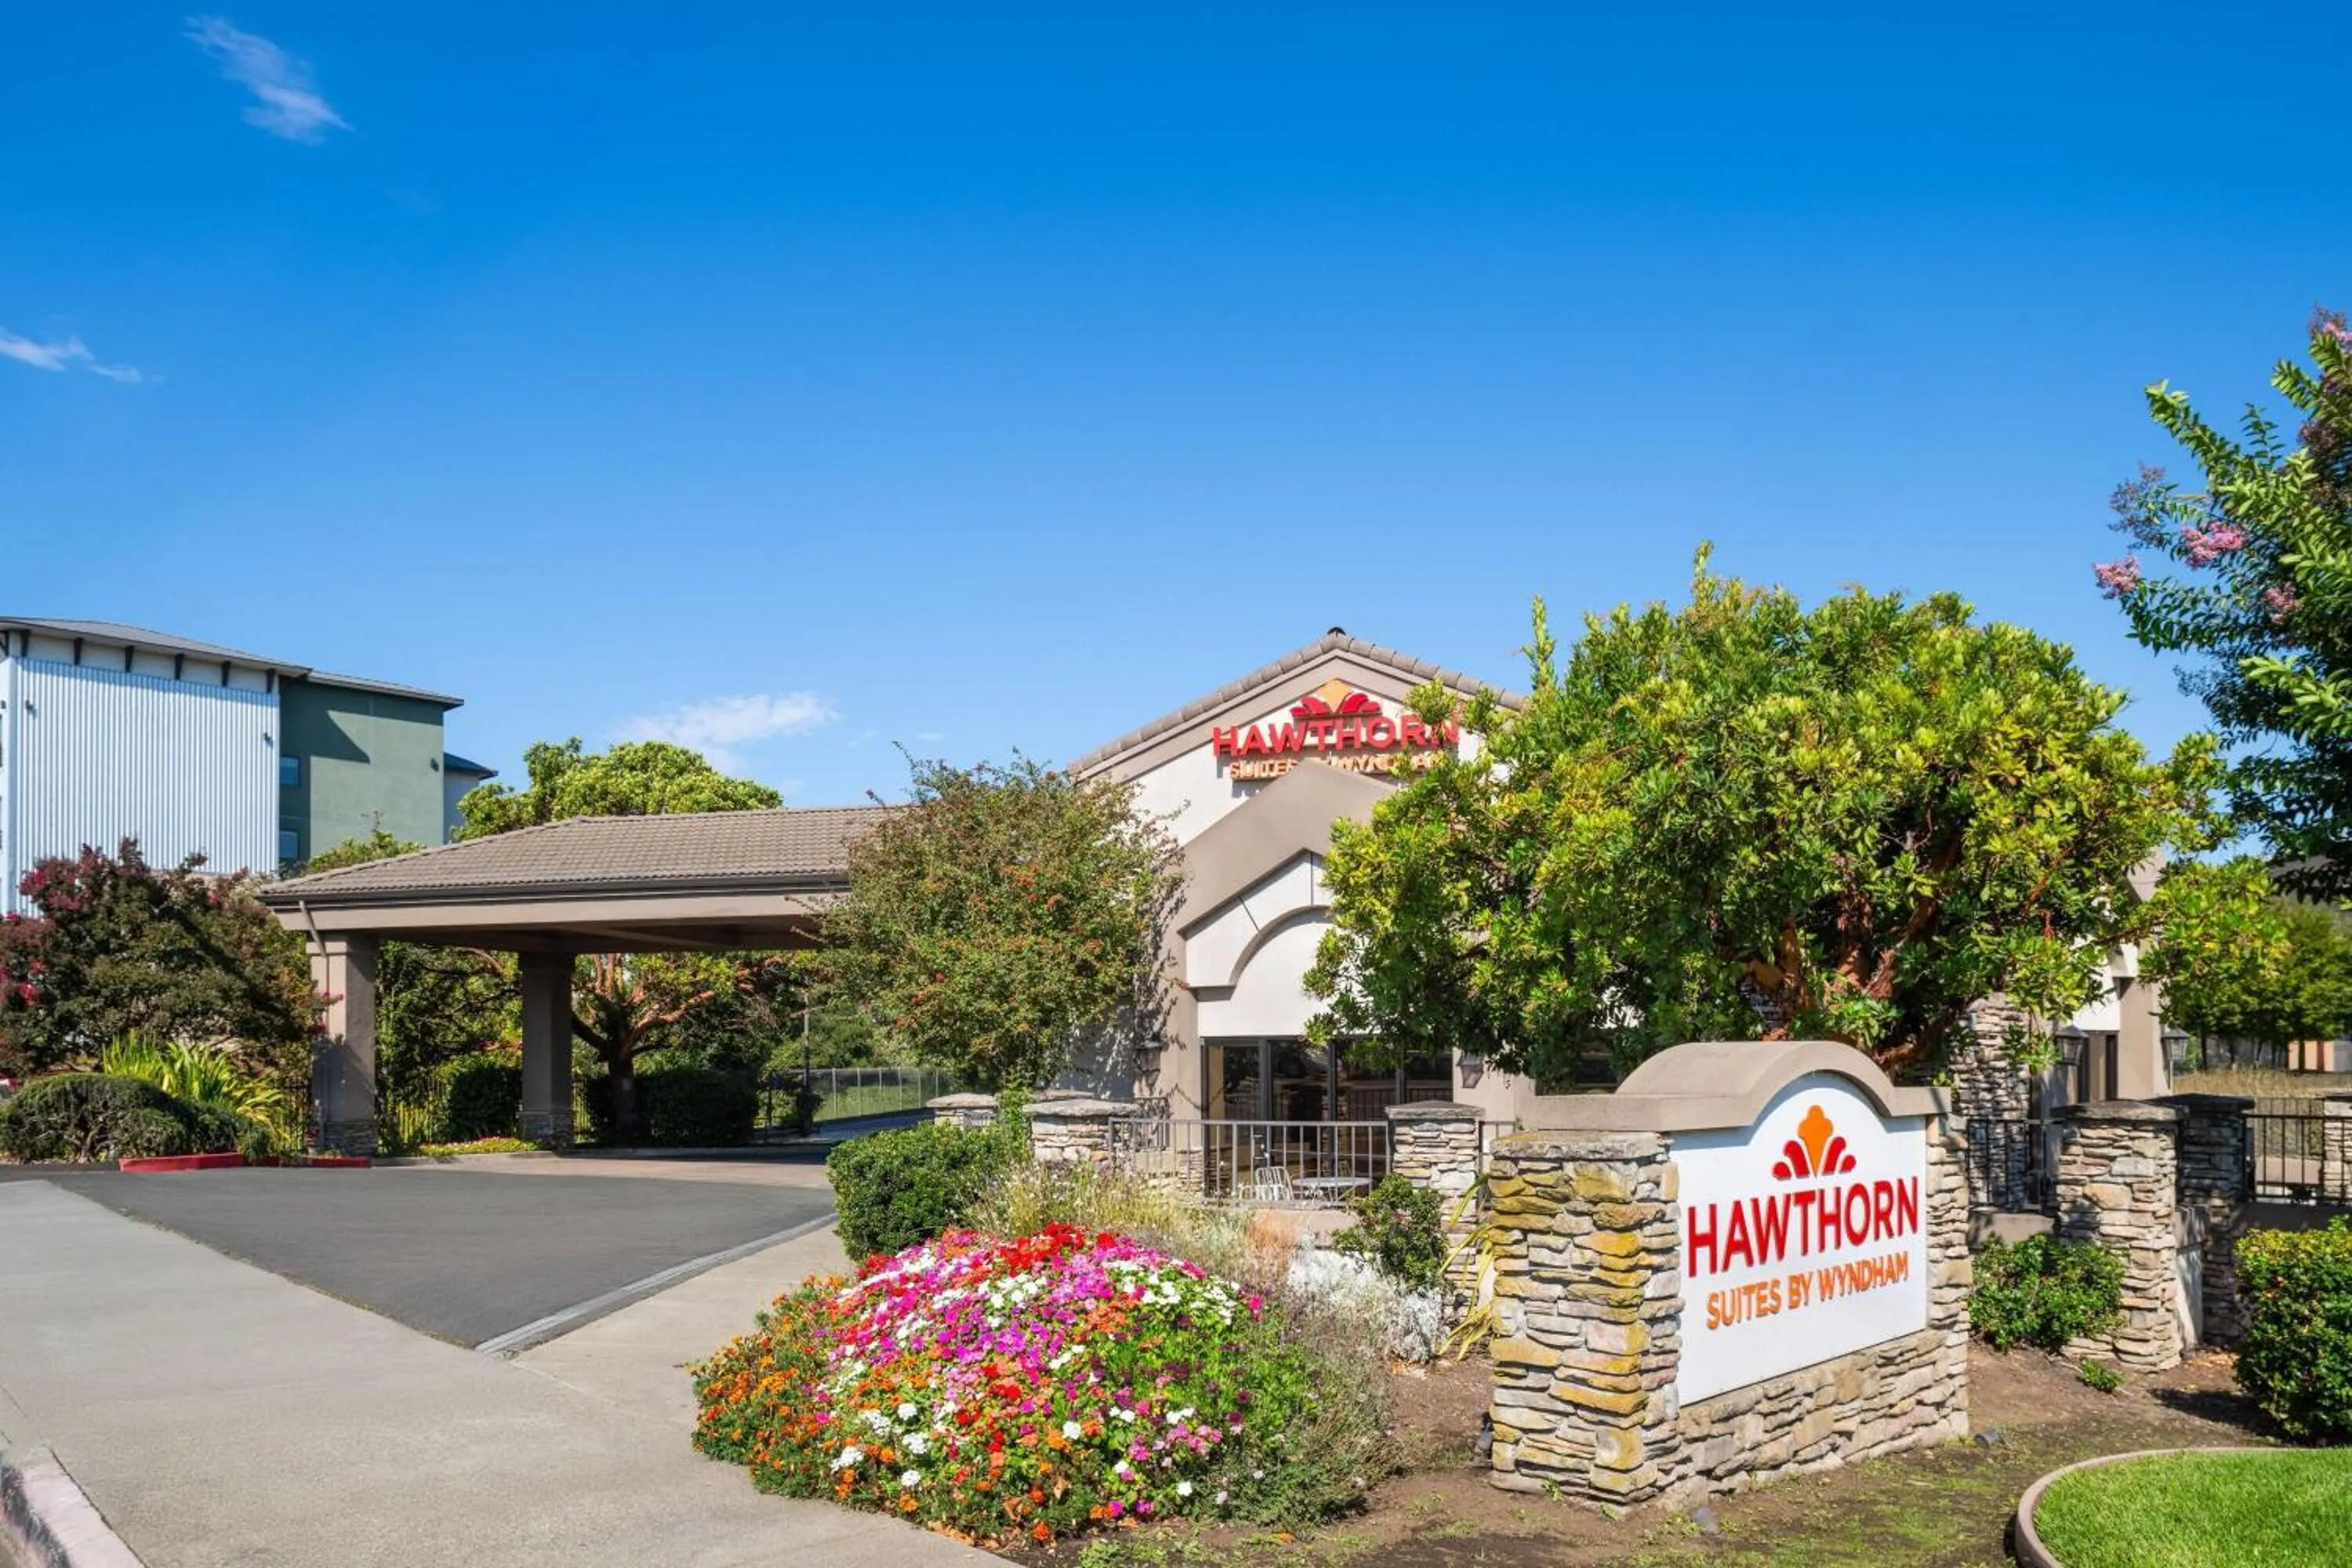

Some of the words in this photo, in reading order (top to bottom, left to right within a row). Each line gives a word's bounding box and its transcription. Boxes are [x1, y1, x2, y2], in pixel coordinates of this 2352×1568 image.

[1213, 712, 1458, 757] HAWTHORN
[1688, 1176, 1918, 1278] HAWTHORN
[1706, 1279, 1781, 1330] SUITES
[1788, 1272, 1813, 1310] BY
[1817, 1250, 1908, 1302] WYNDHAM
